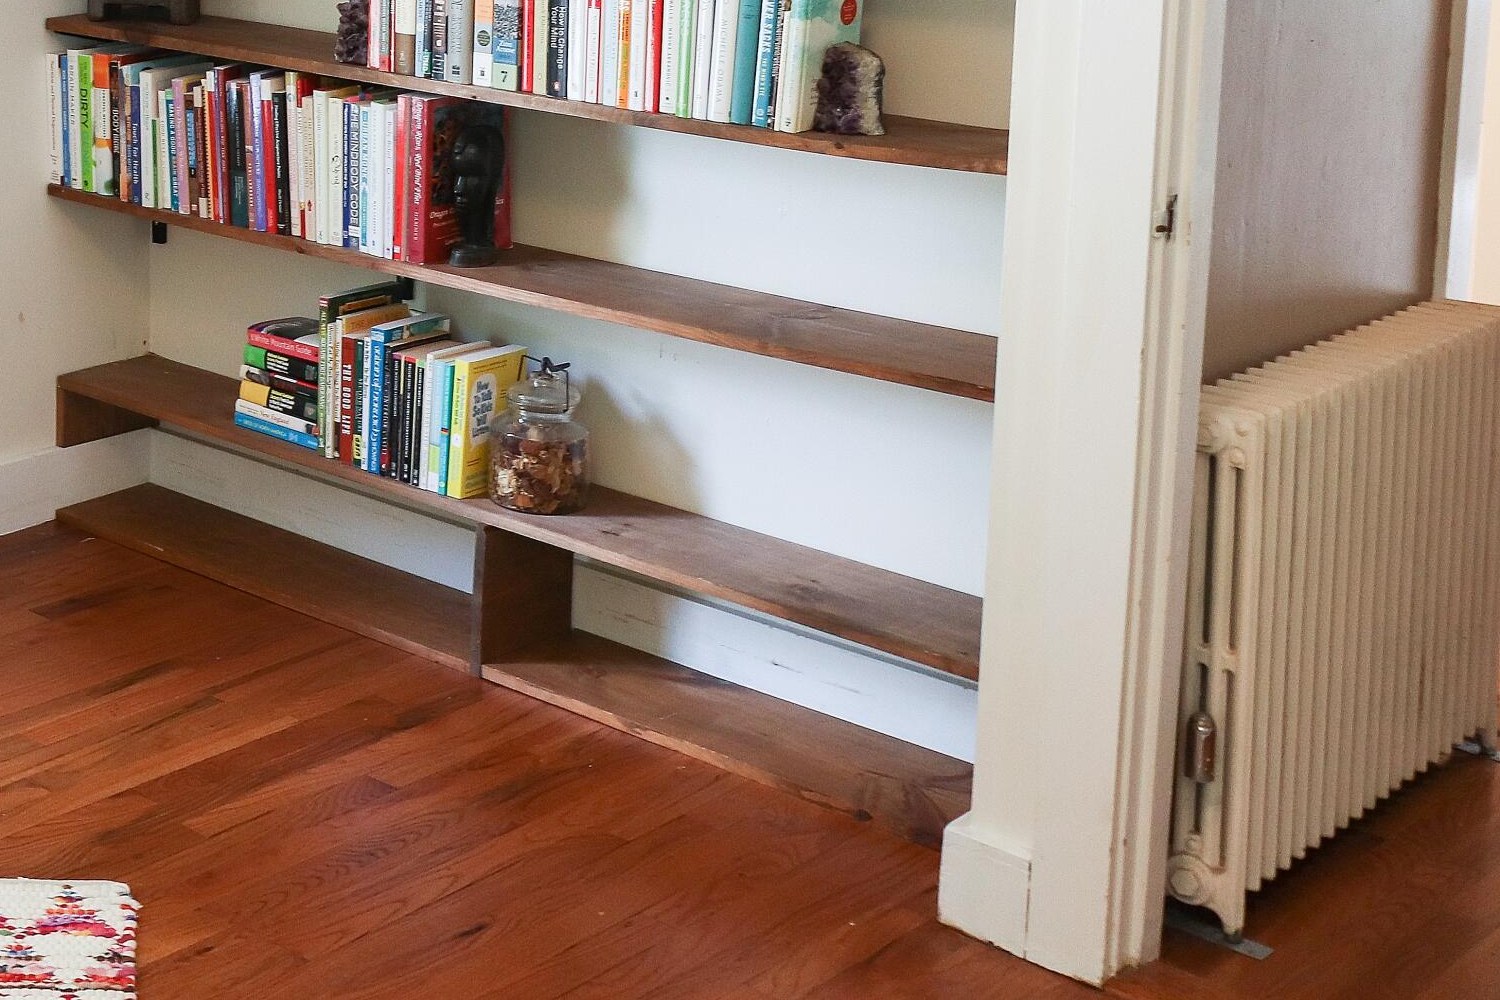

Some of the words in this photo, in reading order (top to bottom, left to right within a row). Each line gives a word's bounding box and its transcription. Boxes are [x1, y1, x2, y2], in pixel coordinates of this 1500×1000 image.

[550, 6, 559, 24] Your
[558, 6, 566, 25] How
[550, 27, 558, 48] Mind
[718, 18, 728, 66] MICHELLE
[761, 23, 773, 53] SACKS
[556, 38, 565, 70] Change
[714, 69, 724, 103] OBAMA
[80, 88, 89, 129] DIRTY
[132, 159, 140, 184] Health
[350, 131, 359, 190] MINDBODY
[350, 193, 358, 224] CODE
[342, 364, 351, 382] THE
[342, 386, 351, 410] GOOD
[341, 414, 351, 435] LIFE
